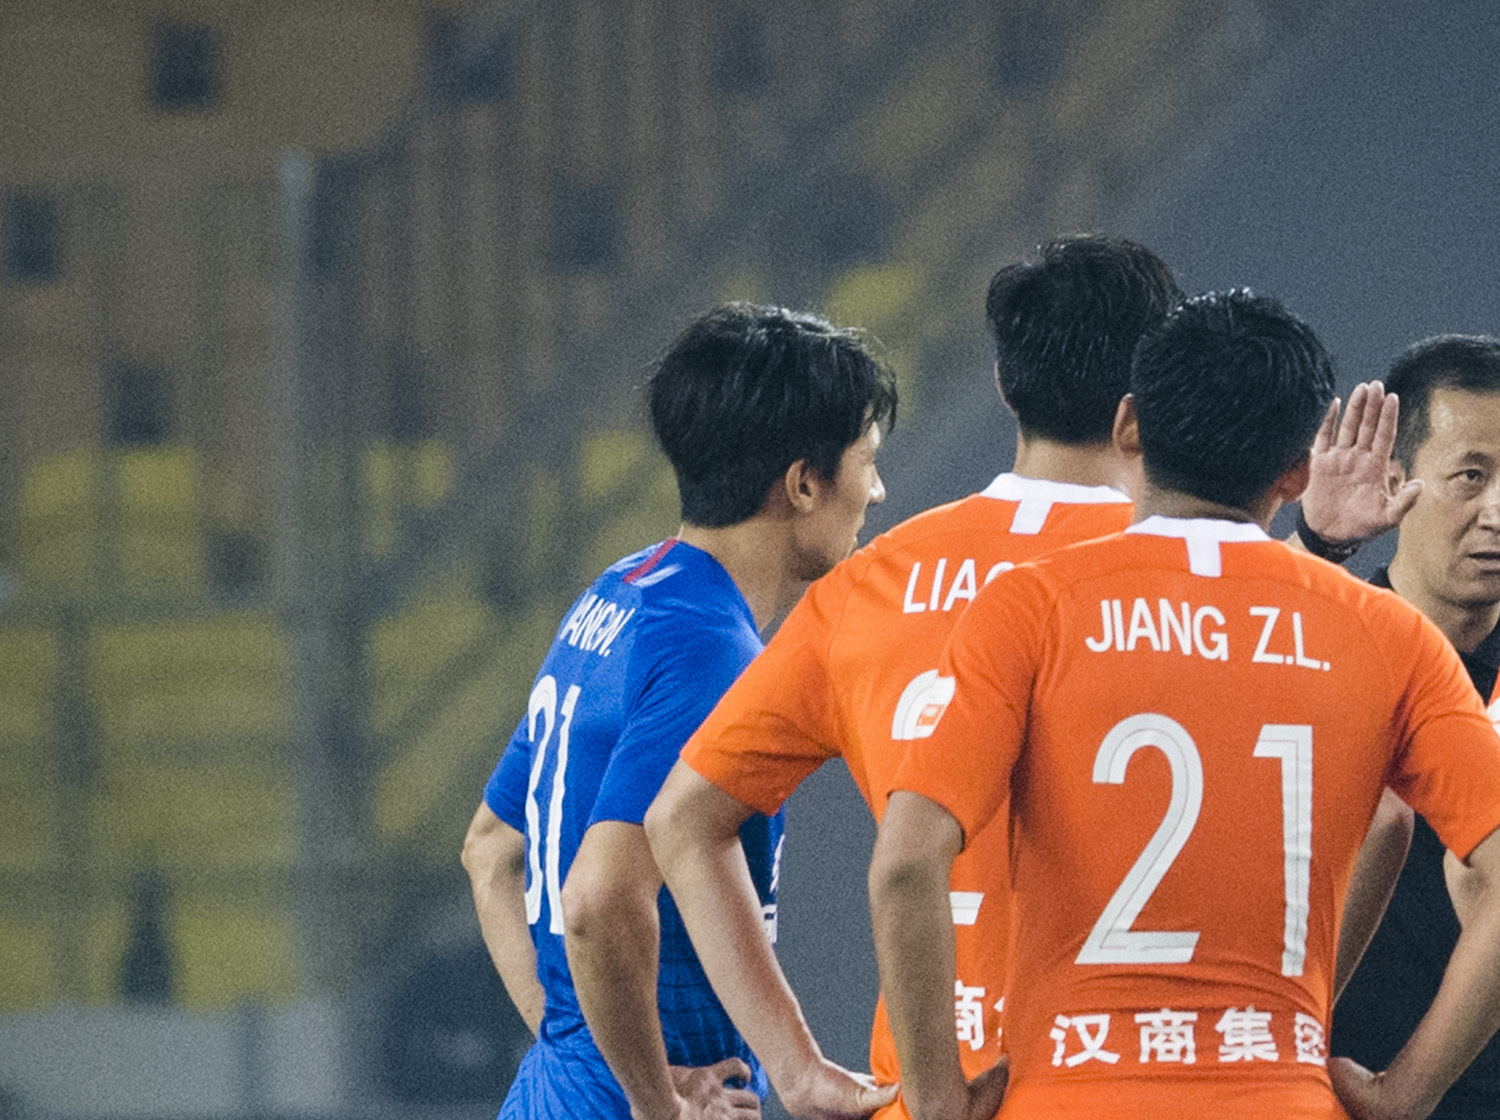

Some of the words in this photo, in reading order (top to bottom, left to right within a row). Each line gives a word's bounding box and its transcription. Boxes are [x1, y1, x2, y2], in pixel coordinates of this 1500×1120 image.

[1085, 597, 1229, 661] JIANG
[1249, 606, 1331, 671] Z.L.
[1074, 712, 1314, 977] 21
